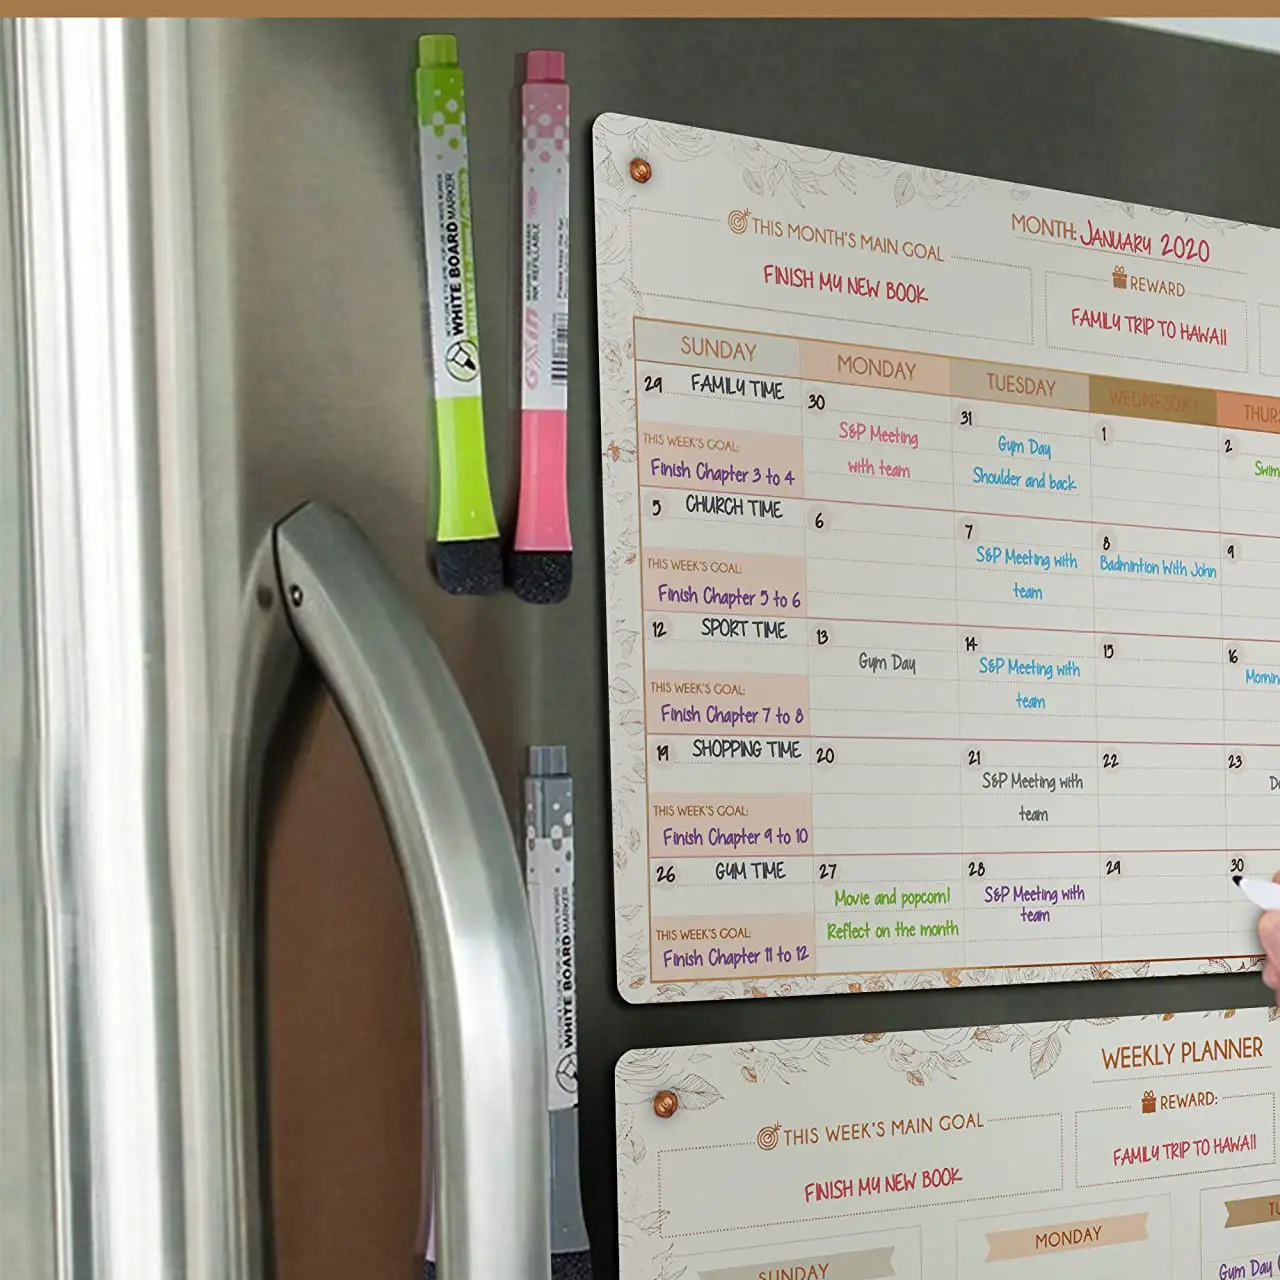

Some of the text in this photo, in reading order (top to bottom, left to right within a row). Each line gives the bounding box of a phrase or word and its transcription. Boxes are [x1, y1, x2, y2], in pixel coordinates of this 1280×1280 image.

[1012, 213, 1077, 240] MONTH:
[448, 222, 459, 279] BOARD
[752, 218, 944, 262] THIS MONTH'S MAIN GOAL
[1080, 220, 1209, 262] JANUARY 2020
[764, 265, 928, 303] FINISH MY NEW BOOK
[1131, 276, 1185, 297] REWARD
[451, 284, 463, 336] WHITE
[1072, 308, 1226, 346] FAMILY TRIP TO HAWAII
[681, 336, 757, 361] SUNDAY
[838, 355, 916, 380] MONDAY
[645, 376, 662, 393] 29
[692, 374, 784, 400] FAMILY TIME
[987, 373, 1056, 397] TUESDAY
[1109, 388, 1200, 413] WEDNESDAY
[643, 433, 664, 445] THIS
[667, 436, 704, 449] WEEK'S
[999, 435, 1051, 460] Gym Day
[651, 458, 795, 486] Finish Chapter 3 to 4
[973, 466, 1077, 491] Shoulder and back
[686, 495, 783, 518] CHURCH TIME
[702, 618, 787, 639] SPORT TIME
[693, 739, 801, 758] SHOPPING TIME
[817, 748, 834, 763] 20
[1229, 755, 1242, 768] 23
[983, 772, 1083, 792] S&P Meeting with
[1019, 805, 1048, 821] team
[657, 866, 675, 882] 26
[716, 862, 786, 880] GYM TIME
[819, 864, 836, 879] 27
[563, 935, 573, 991] BOARD
[564, 996, 574, 1049] WHITE
[1102, 1037, 1262, 1069] WEEKLY PLANNER
[1160, 1091, 1218, 1110] REWARD:
[784, 1113, 984, 1146] THIS WEEK'S MAIN GOAL
[1114, 1134, 1256, 1166] FAMILY TRIP TO HAWAII
[805, 1168, 962, 1202] FINISH MY NEW BOOK
[1036, 1226, 1101, 1249] MONDAY
[1250, 1259, 1272, 1277] Day
